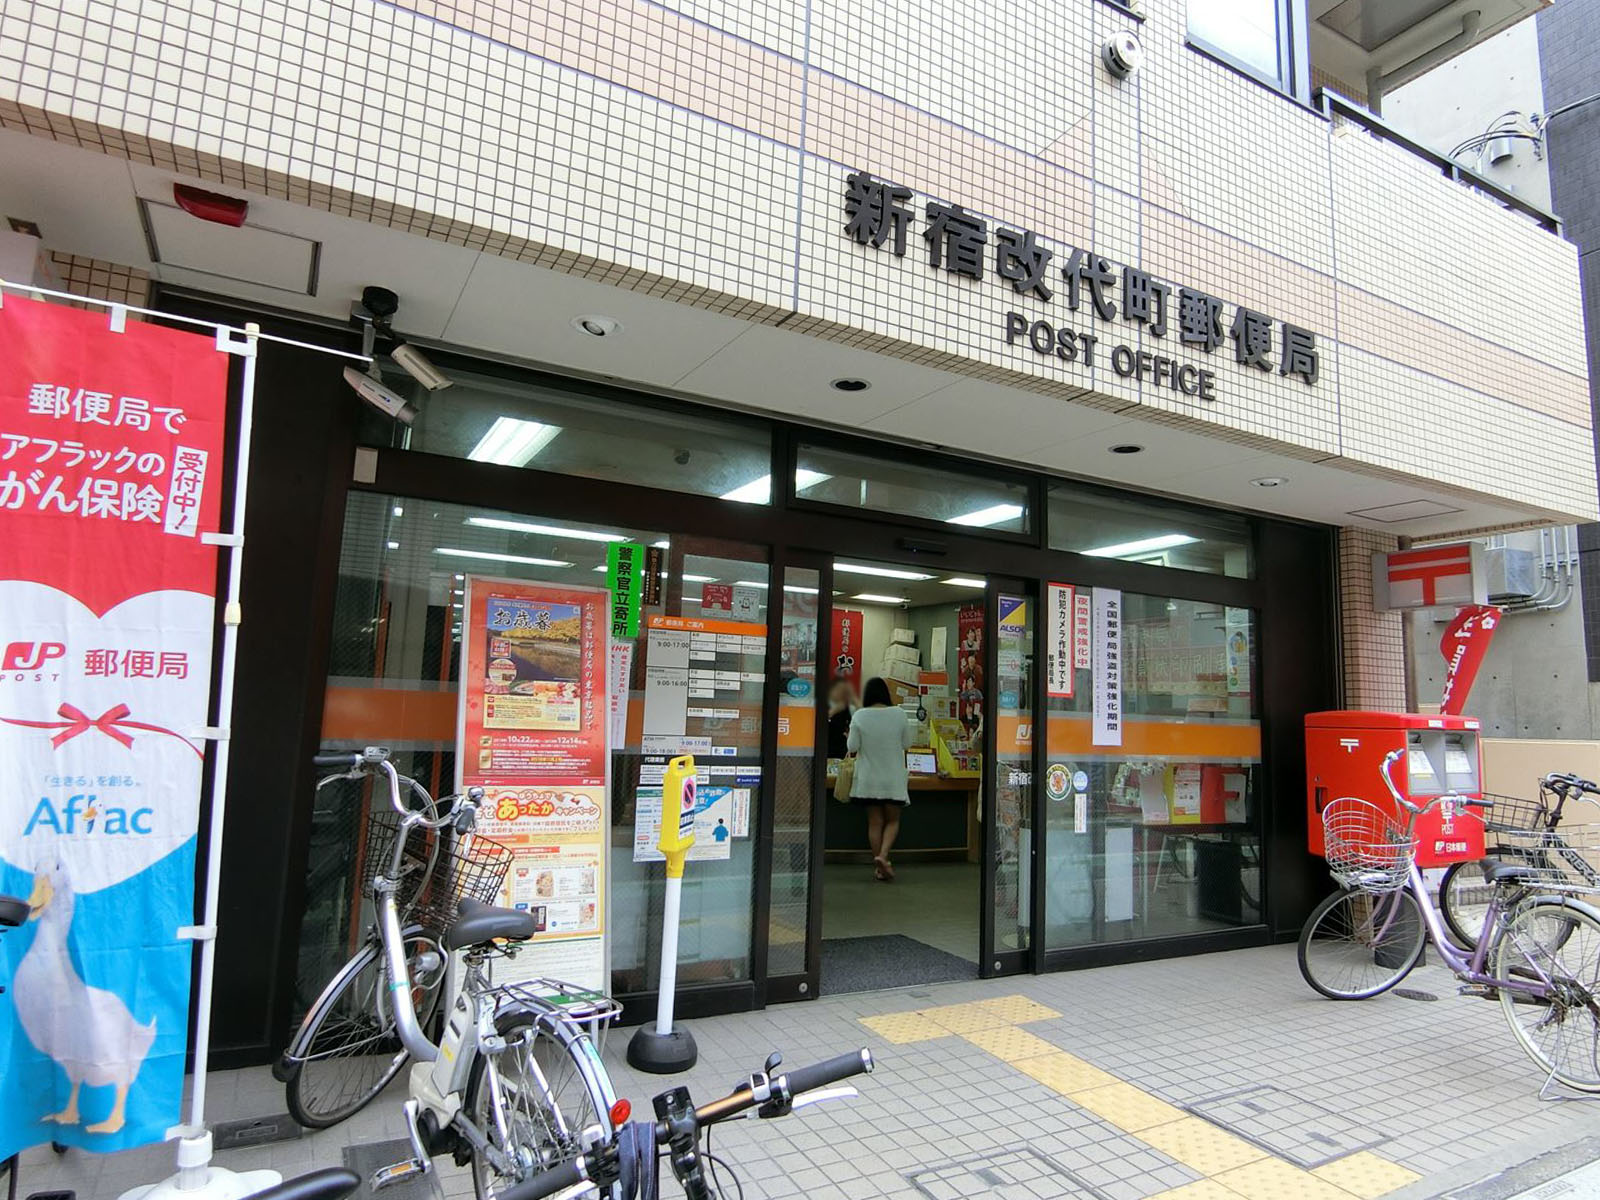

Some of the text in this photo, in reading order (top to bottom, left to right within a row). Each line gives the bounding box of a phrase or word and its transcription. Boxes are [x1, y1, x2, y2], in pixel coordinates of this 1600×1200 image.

[844, 171, 1320, 385] 新宿改代町郵便局
[1006, 311, 1217, 402] POST OFFICE
[28, 383, 187, 434] 郵便局で
[0, 432, 165, 476] アフラックの
[0, 469, 164, 523] がん保険
[612, 547, 633, 635] 警察官立寄所
[494, 607, 552, 633] お歳暮
[1058, 589, 1067, 690] 防犯カメラ作動中です
[0, 673, 60, 682] POST
[84, 649, 189, 679] 郵便局
[1106, 600, 1118, 731] 全国郵便局強盗対策強化期間
[23, 795, 153, 836] Aflac
